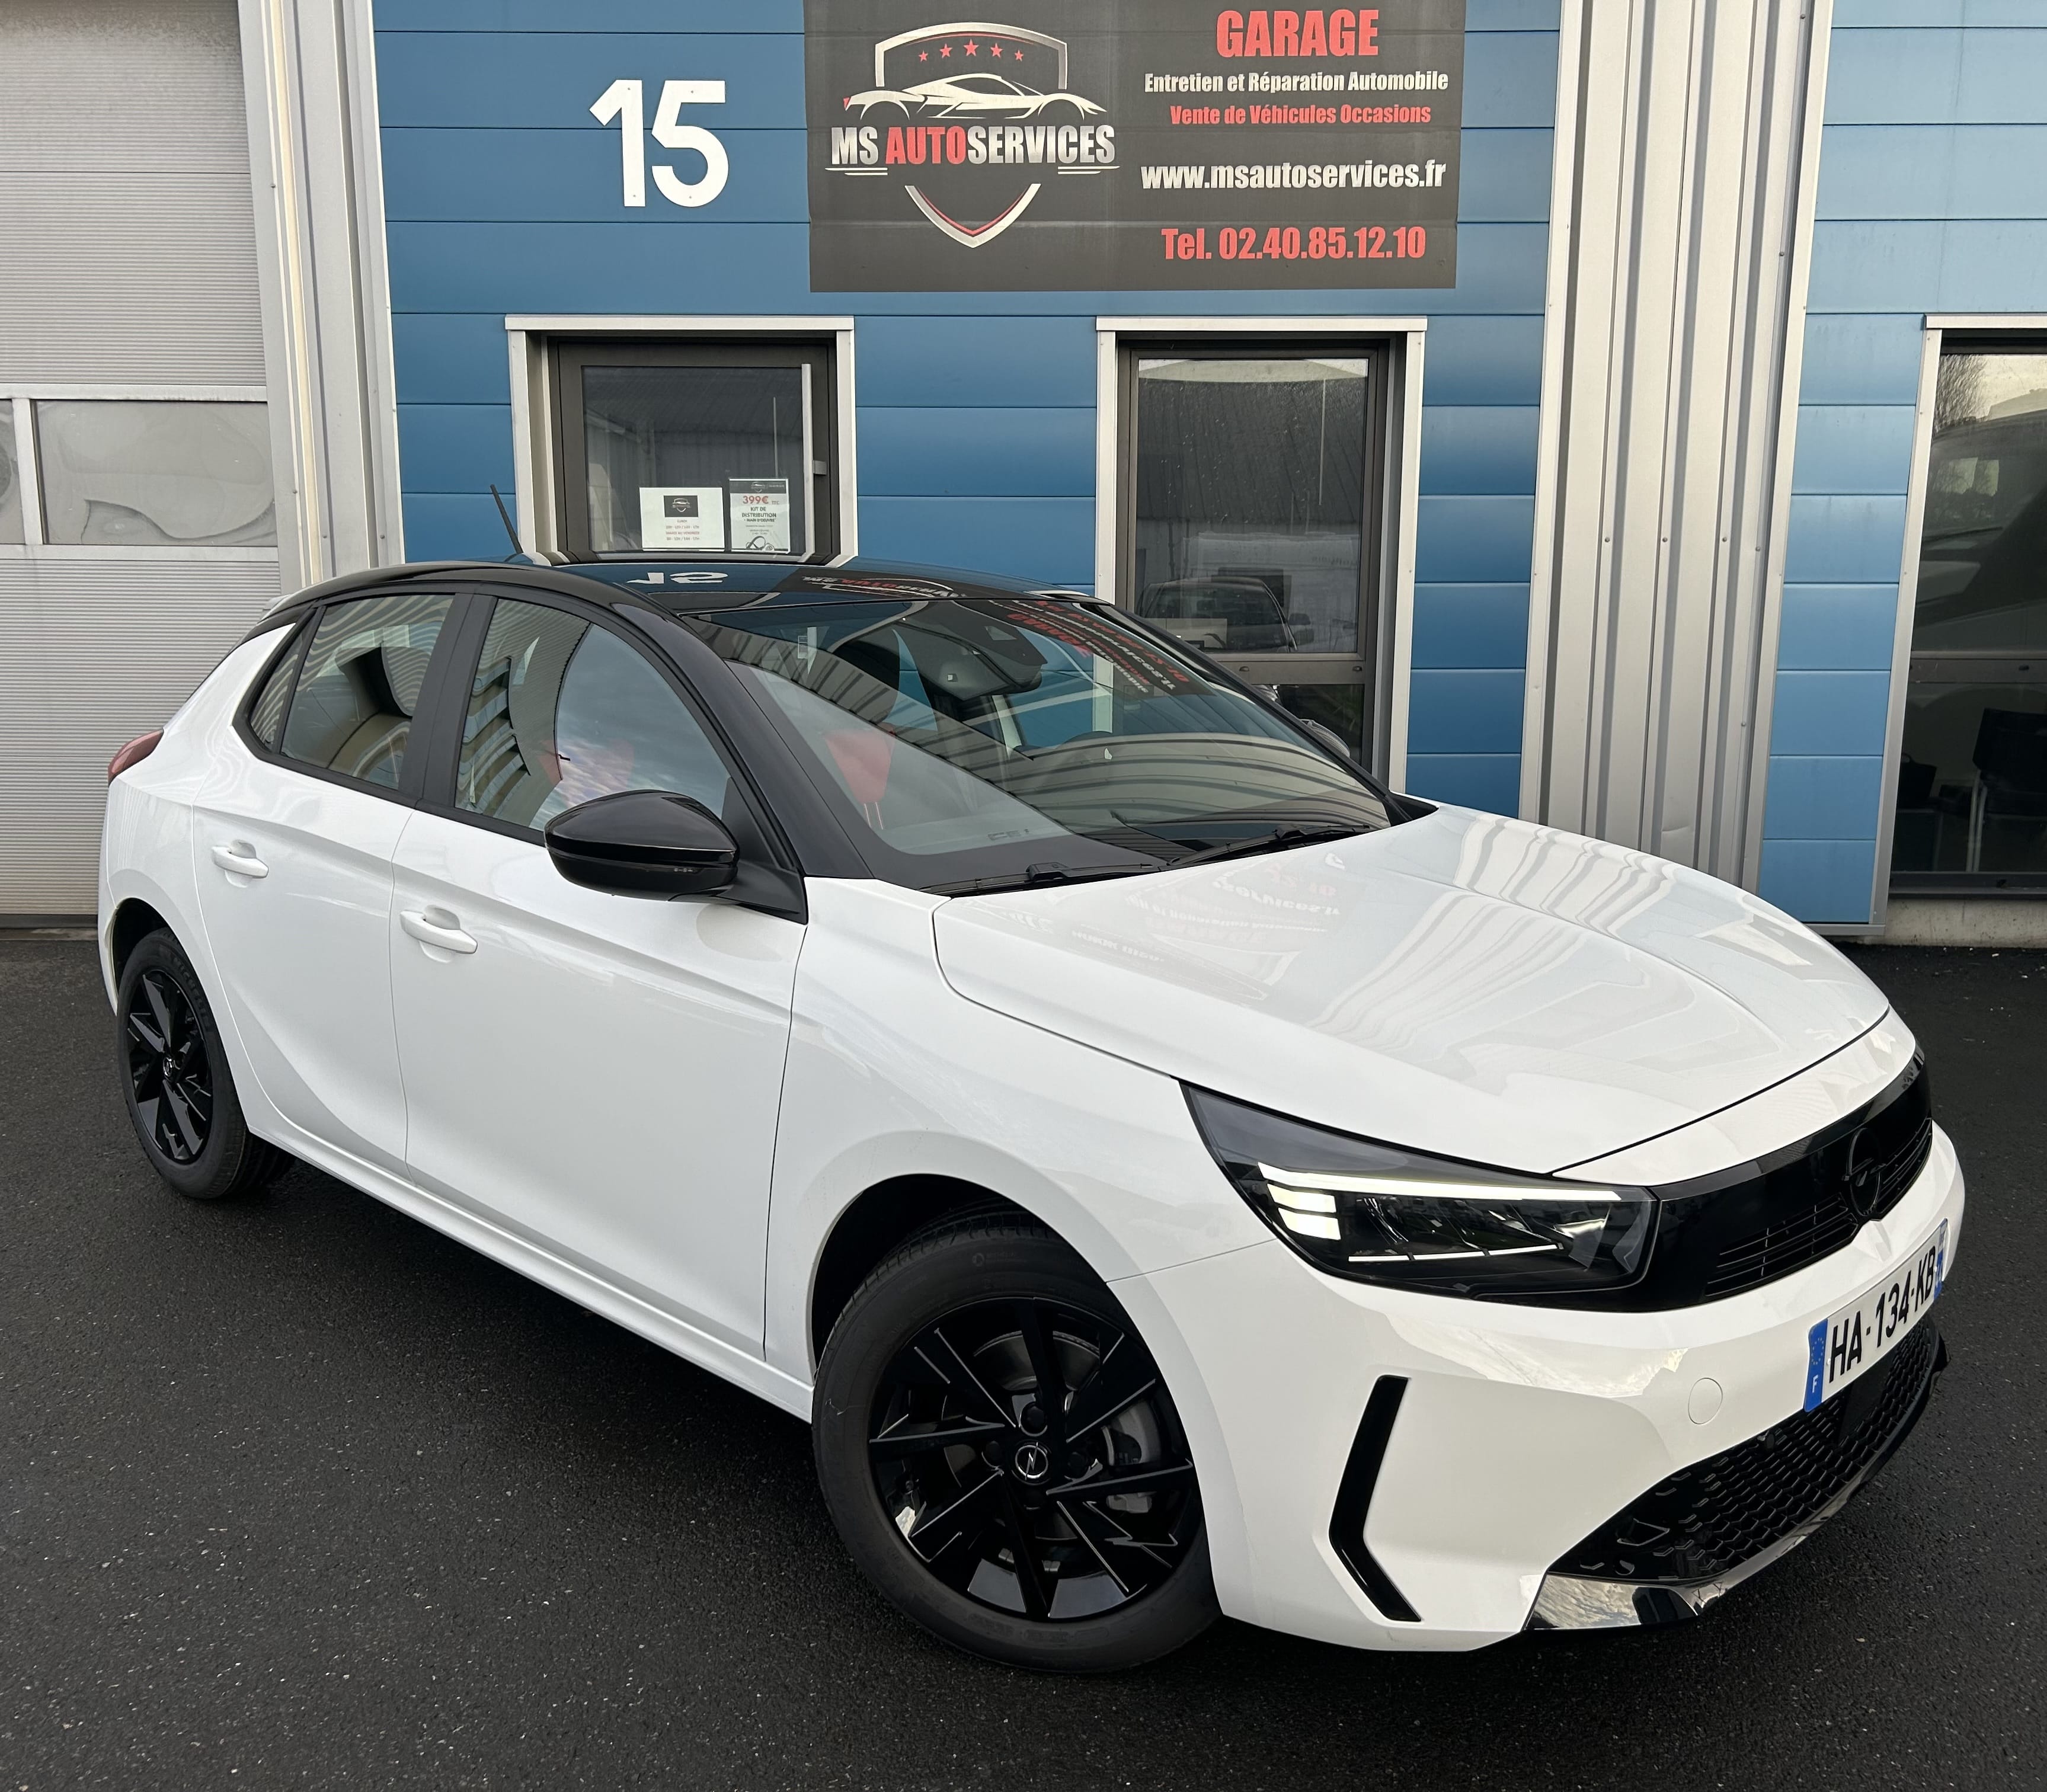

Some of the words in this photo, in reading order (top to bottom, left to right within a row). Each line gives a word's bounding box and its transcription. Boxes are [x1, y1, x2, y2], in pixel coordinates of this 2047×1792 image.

[1216, 9, 1379, 58] GARAGE
[1144, 72, 1223, 92] Entretien
[1227, 73, 1245, 92] et
[1248, 71, 1345, 94] Réparation
[1347, 71, 1448, 91] Automobile
[1170, 105, 1221, 125] Vente
[1223, 105, 1246, 124] de
[1249, 104, 1337, 124] Véhicules
[1339, 103, 1431, 124] Occasions
[589, 79, 729, 207] 15
[831, 126, 879, 165] MS
[885, 124, 1116, 165] AUTOSERVICES
[1140, 159, 1447, 190] www.msautoservices.fr
[1160, 228, 1212, 260] Tel.
[1218, 226, 1426, 260] 02.40.85.12.10
[743, 495, 769, 504] 399€
[1829, 1246, 1936, 1383] HA-134-KB
